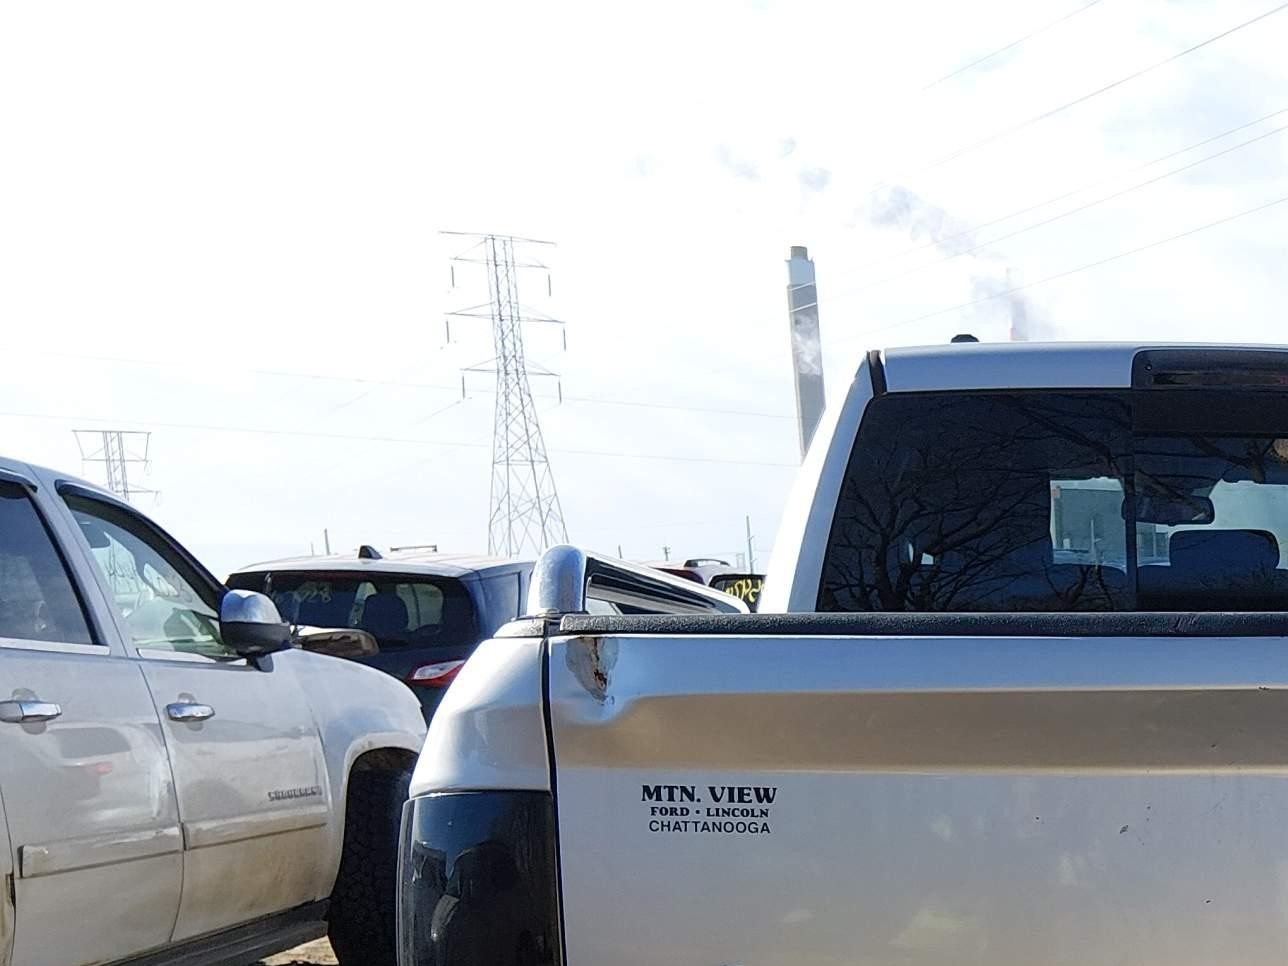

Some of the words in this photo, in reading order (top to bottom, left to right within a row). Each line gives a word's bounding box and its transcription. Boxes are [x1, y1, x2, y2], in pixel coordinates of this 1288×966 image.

[642, 785, 702, 802] MTN.
[708, 786, 777, 804] VIEW
[650, 807, 690, 817] FORD
[706, 808, 769, 818] LINCOLN
[649, 820, 771, 834] CHATTANOOGA
